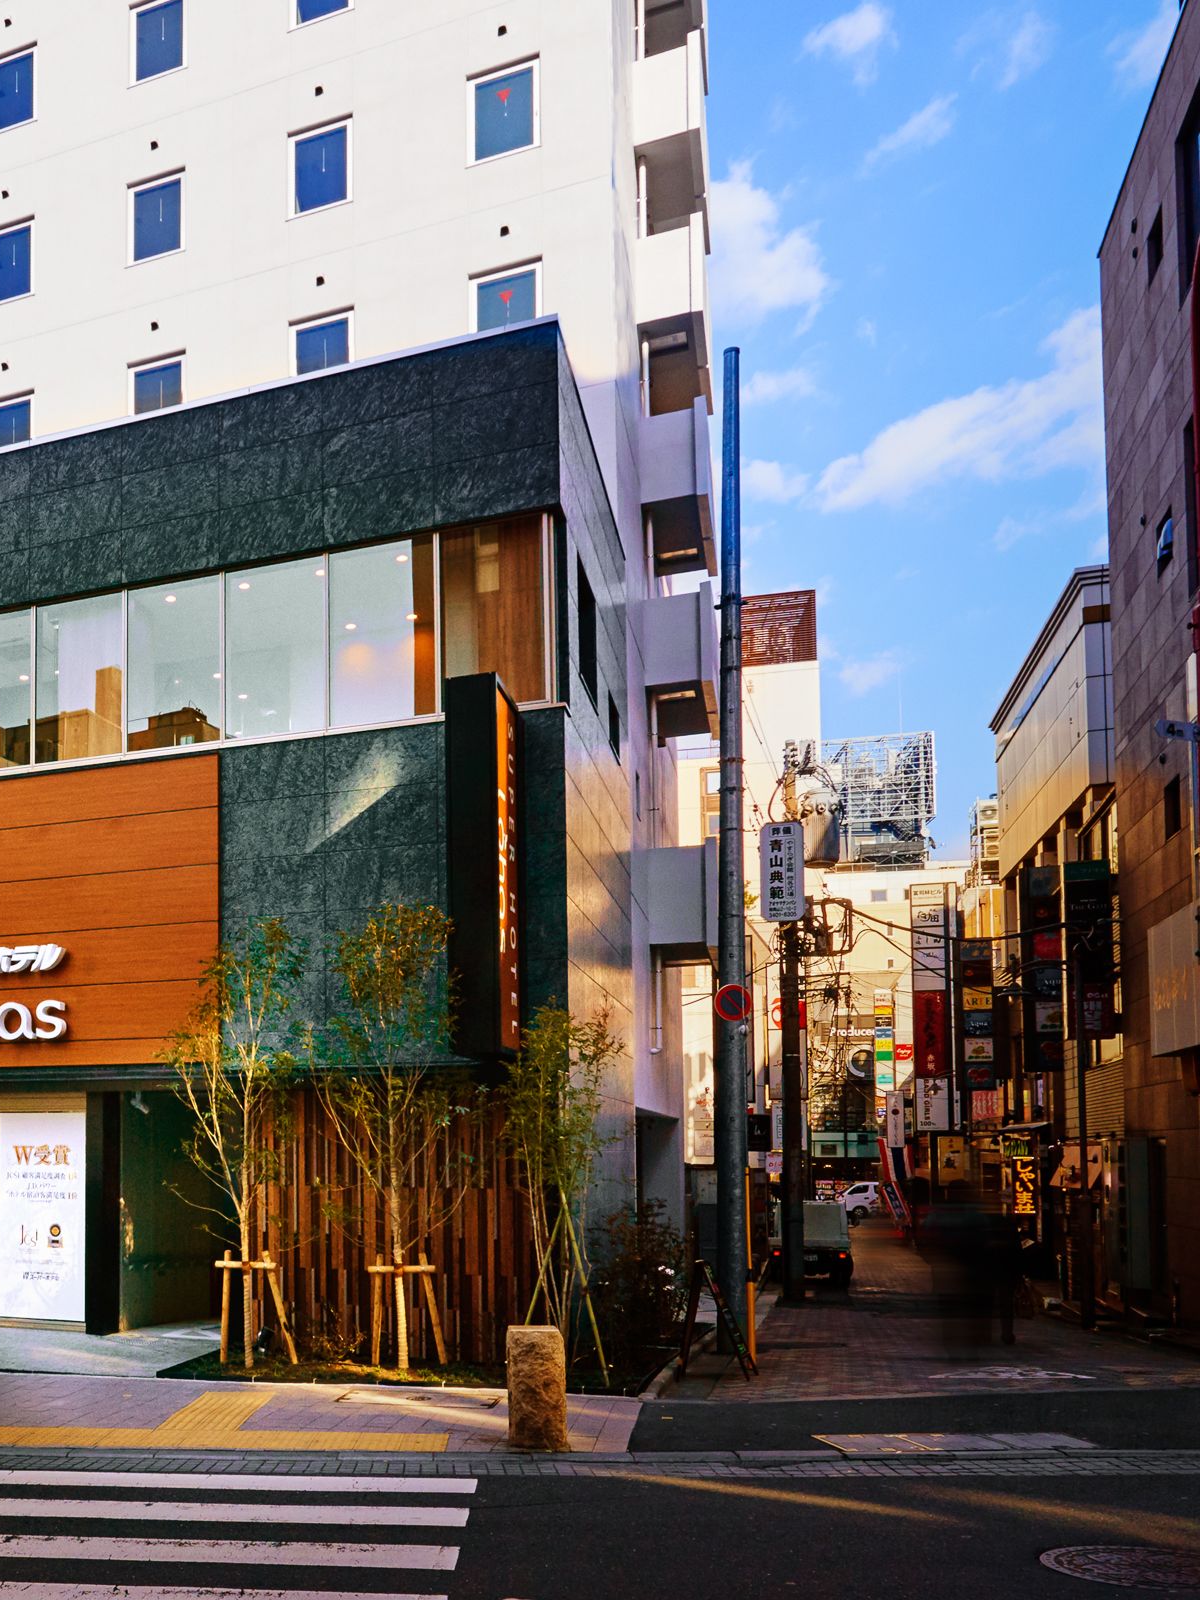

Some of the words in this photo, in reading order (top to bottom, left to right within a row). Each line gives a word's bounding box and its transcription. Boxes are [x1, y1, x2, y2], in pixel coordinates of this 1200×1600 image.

[507, 723, 515, 863] SUPER
[769, 839, 784, 900] 青山典範
[509, 892, 518, 1034] HOTEL
[12, 1144, 71, 1167] W受賞
